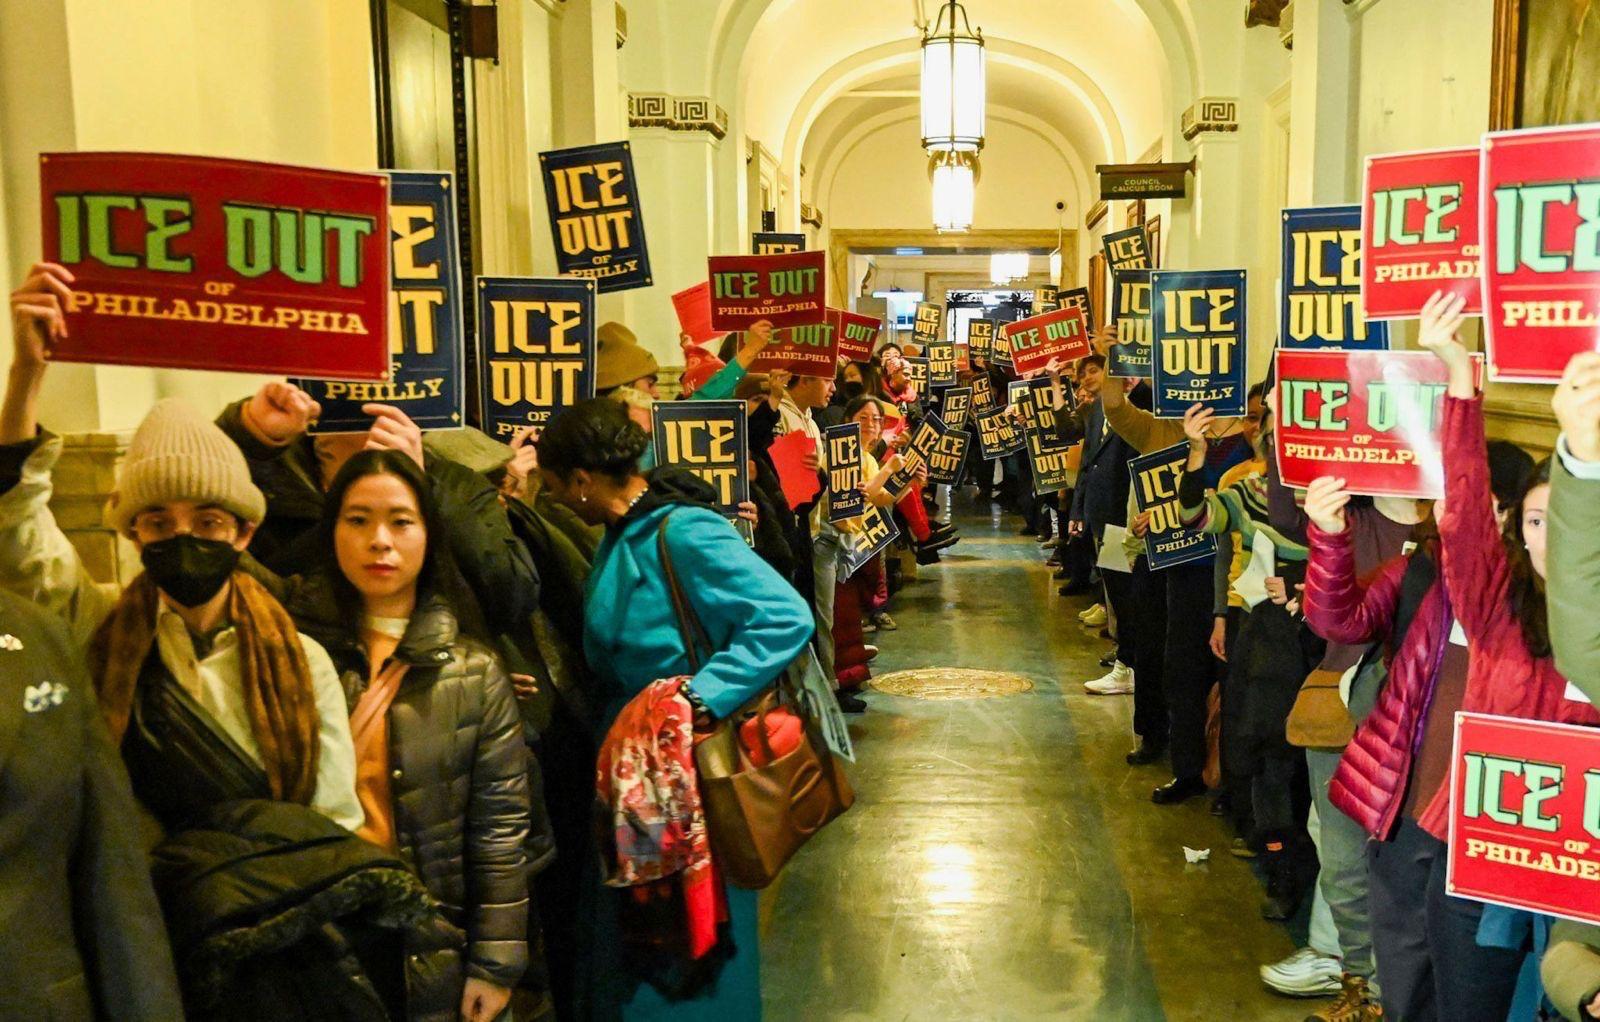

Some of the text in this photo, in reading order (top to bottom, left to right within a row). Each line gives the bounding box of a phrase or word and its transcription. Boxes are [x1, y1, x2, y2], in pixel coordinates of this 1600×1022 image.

[550, 161, 628, 213] ICE
[1124, 178, 1161, 186] COUNCIL
[1148, 184, 1175, 192] ROOM
[1373, 184, 1462, 248] ICE
[54, 195, 193, 273] ICE
[222, 203, 376, 288] OUT
[556, 210, 633, 256] OUT
[1108, 235, 1145, 262] ICE
[592, 254, 613, 265] OF
[569, 260, 639, 279] PHILLY
[204, 282, 236, 297] OF
[713, 272, 760, 299] ICE
[768, 267, 819, 297] OUT
[1120, 283, 1151, 314] IC
[69, 290, 369, 335] PHILADELPHIA
[718, 301, 819, 316] PHILADELPHIA
[917, 306, 940, 323] ICE
[1162, 288, 1235, 333] ICE
[1288, 293, 1366, 342] OUT
[489, 301, 581, 354] ICE
[791, 324, 834, 347] OUT
[845, 323, 876, 342] OUT
[915, 320, 938, 335] OUT
[971, 323, 991, 336] ICE
[1010, 327, 1041, 352] ICE
[1044, 319, 1079, 341] OUT
[1117, 318, 1152, 346] OU
[970, 336, 991, 348] OUT
[996, 339, 1010, 352] OU
[1017, 340, 1084, 363] PHILADELPHIA
[930, 346, 952, 360] ICE
[1118, 355, 1151, 366] PHIL
[1160, 336, 1237, 376] OUT
[911, 364, 926, 378] CE
[930, 360, 953, 373] OUT
[324, 377, 445, 401] PHILLY
[489, 361, 583, 406] OUT
[973, 377, 990, 394] ICE
[1190, 378, 1209, 388] OF
[947, 394, 968, 411] ICE
[974, 391, 991, 405] OUT
[1165, 386, 1235, 401] PHILLY
[1280, 380, 1350, 431] ICE
[527, 411, 551, 422] OF
[944, 410, 965, 424] OUT
[663, 420, 735, 463] ICE
[982, 431, 999, 445] OU
[1352, 435, 1372, 445] OF
[830, 435, 858, 466] ICE
[931, 452, 961, 472] OUT
[1034, 452, 1068, 474] OUT
[830, 466, 860, 494] OUT
[833, 498, 861, 510] PHILLY
[1145, 499, 1182, 534] OU
[1155, 532, 1205, 554] PHILLY
[1172, 530, 1186, 539] OF
[1463, 752, 1564, 832] ICE
[1564, 839, 1590, 854] OF
